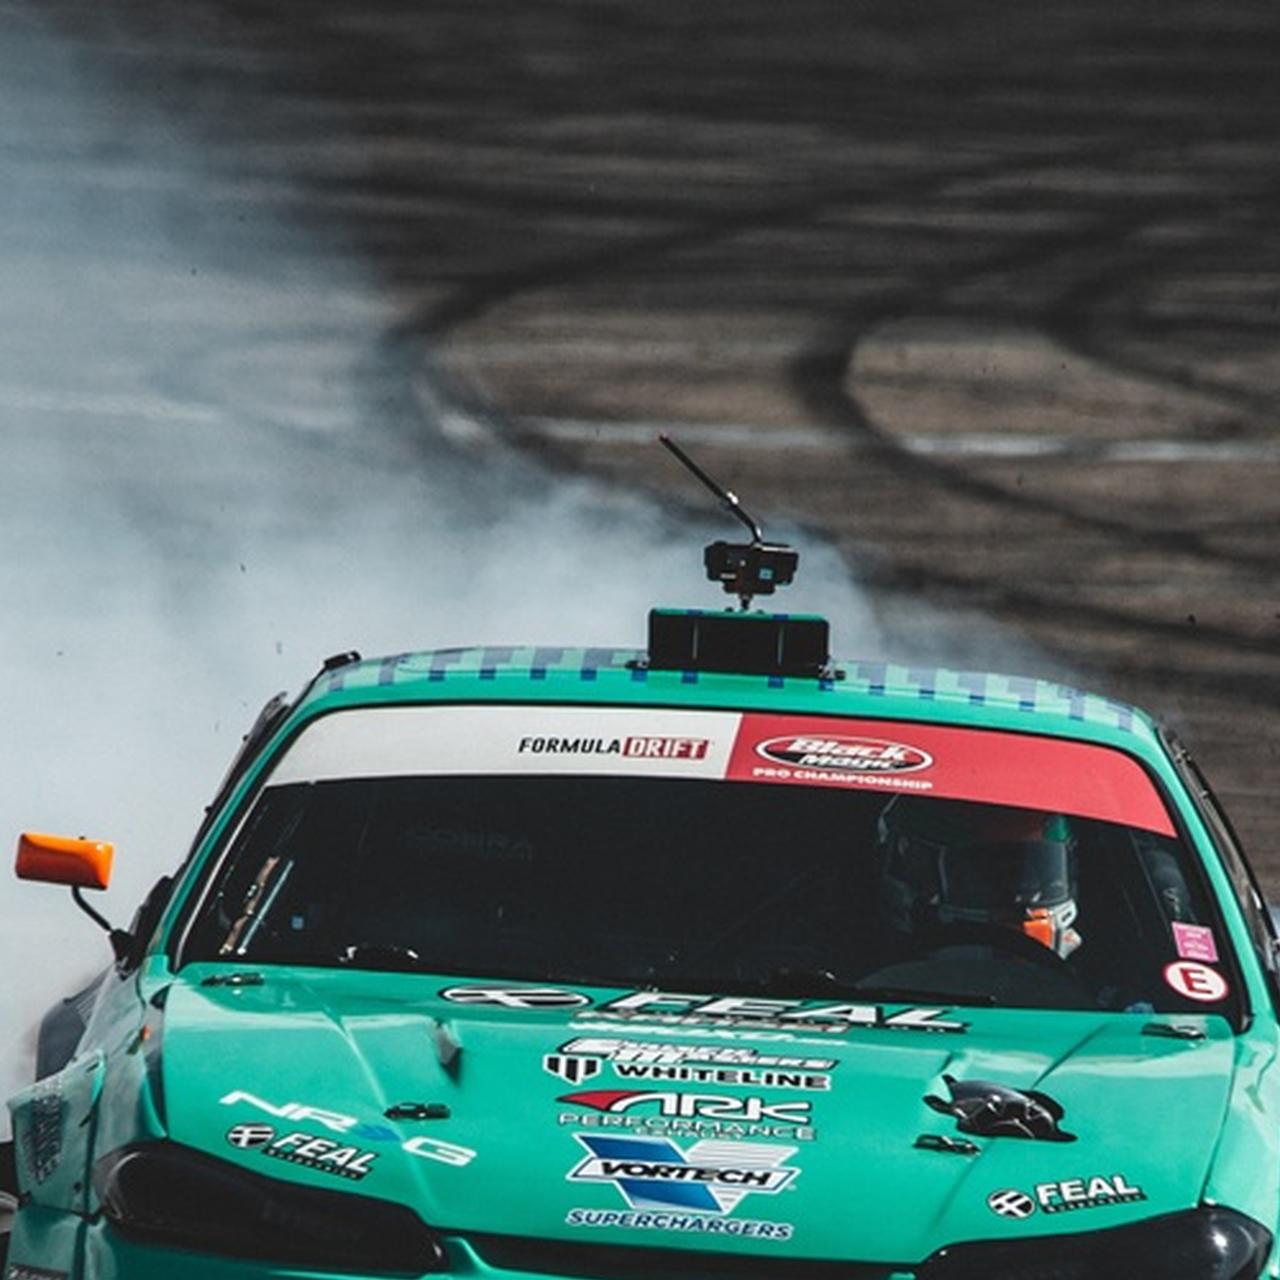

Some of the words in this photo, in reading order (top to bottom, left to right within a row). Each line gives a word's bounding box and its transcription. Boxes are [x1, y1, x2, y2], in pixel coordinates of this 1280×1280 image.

[518, 736, 621, 755] FORMULA
[625, 736, 704, 759] DRIFT
[786, 738, 908, 761] Black
[752, 767, 790, 778] PRO
[793, 771, 933, 790] CHAMPIONSHIP
[1179, 967, 1214, 995] E
[610, 992, 966, 1031] FEAL
[615, 1064, 828, 1089] WHITELINE
[600, 1092, 810, 1124] ARK
[559, 1113, 815, 1141] PERFORMANCE
[272, 1132, 377, 1173] FEAL
[599, 1161, 773, 1186] VORTECH
[1035, 1175, 1140, 1206] FEAL
[566, 1209, 794, 1239] SUPERCHARGERS
